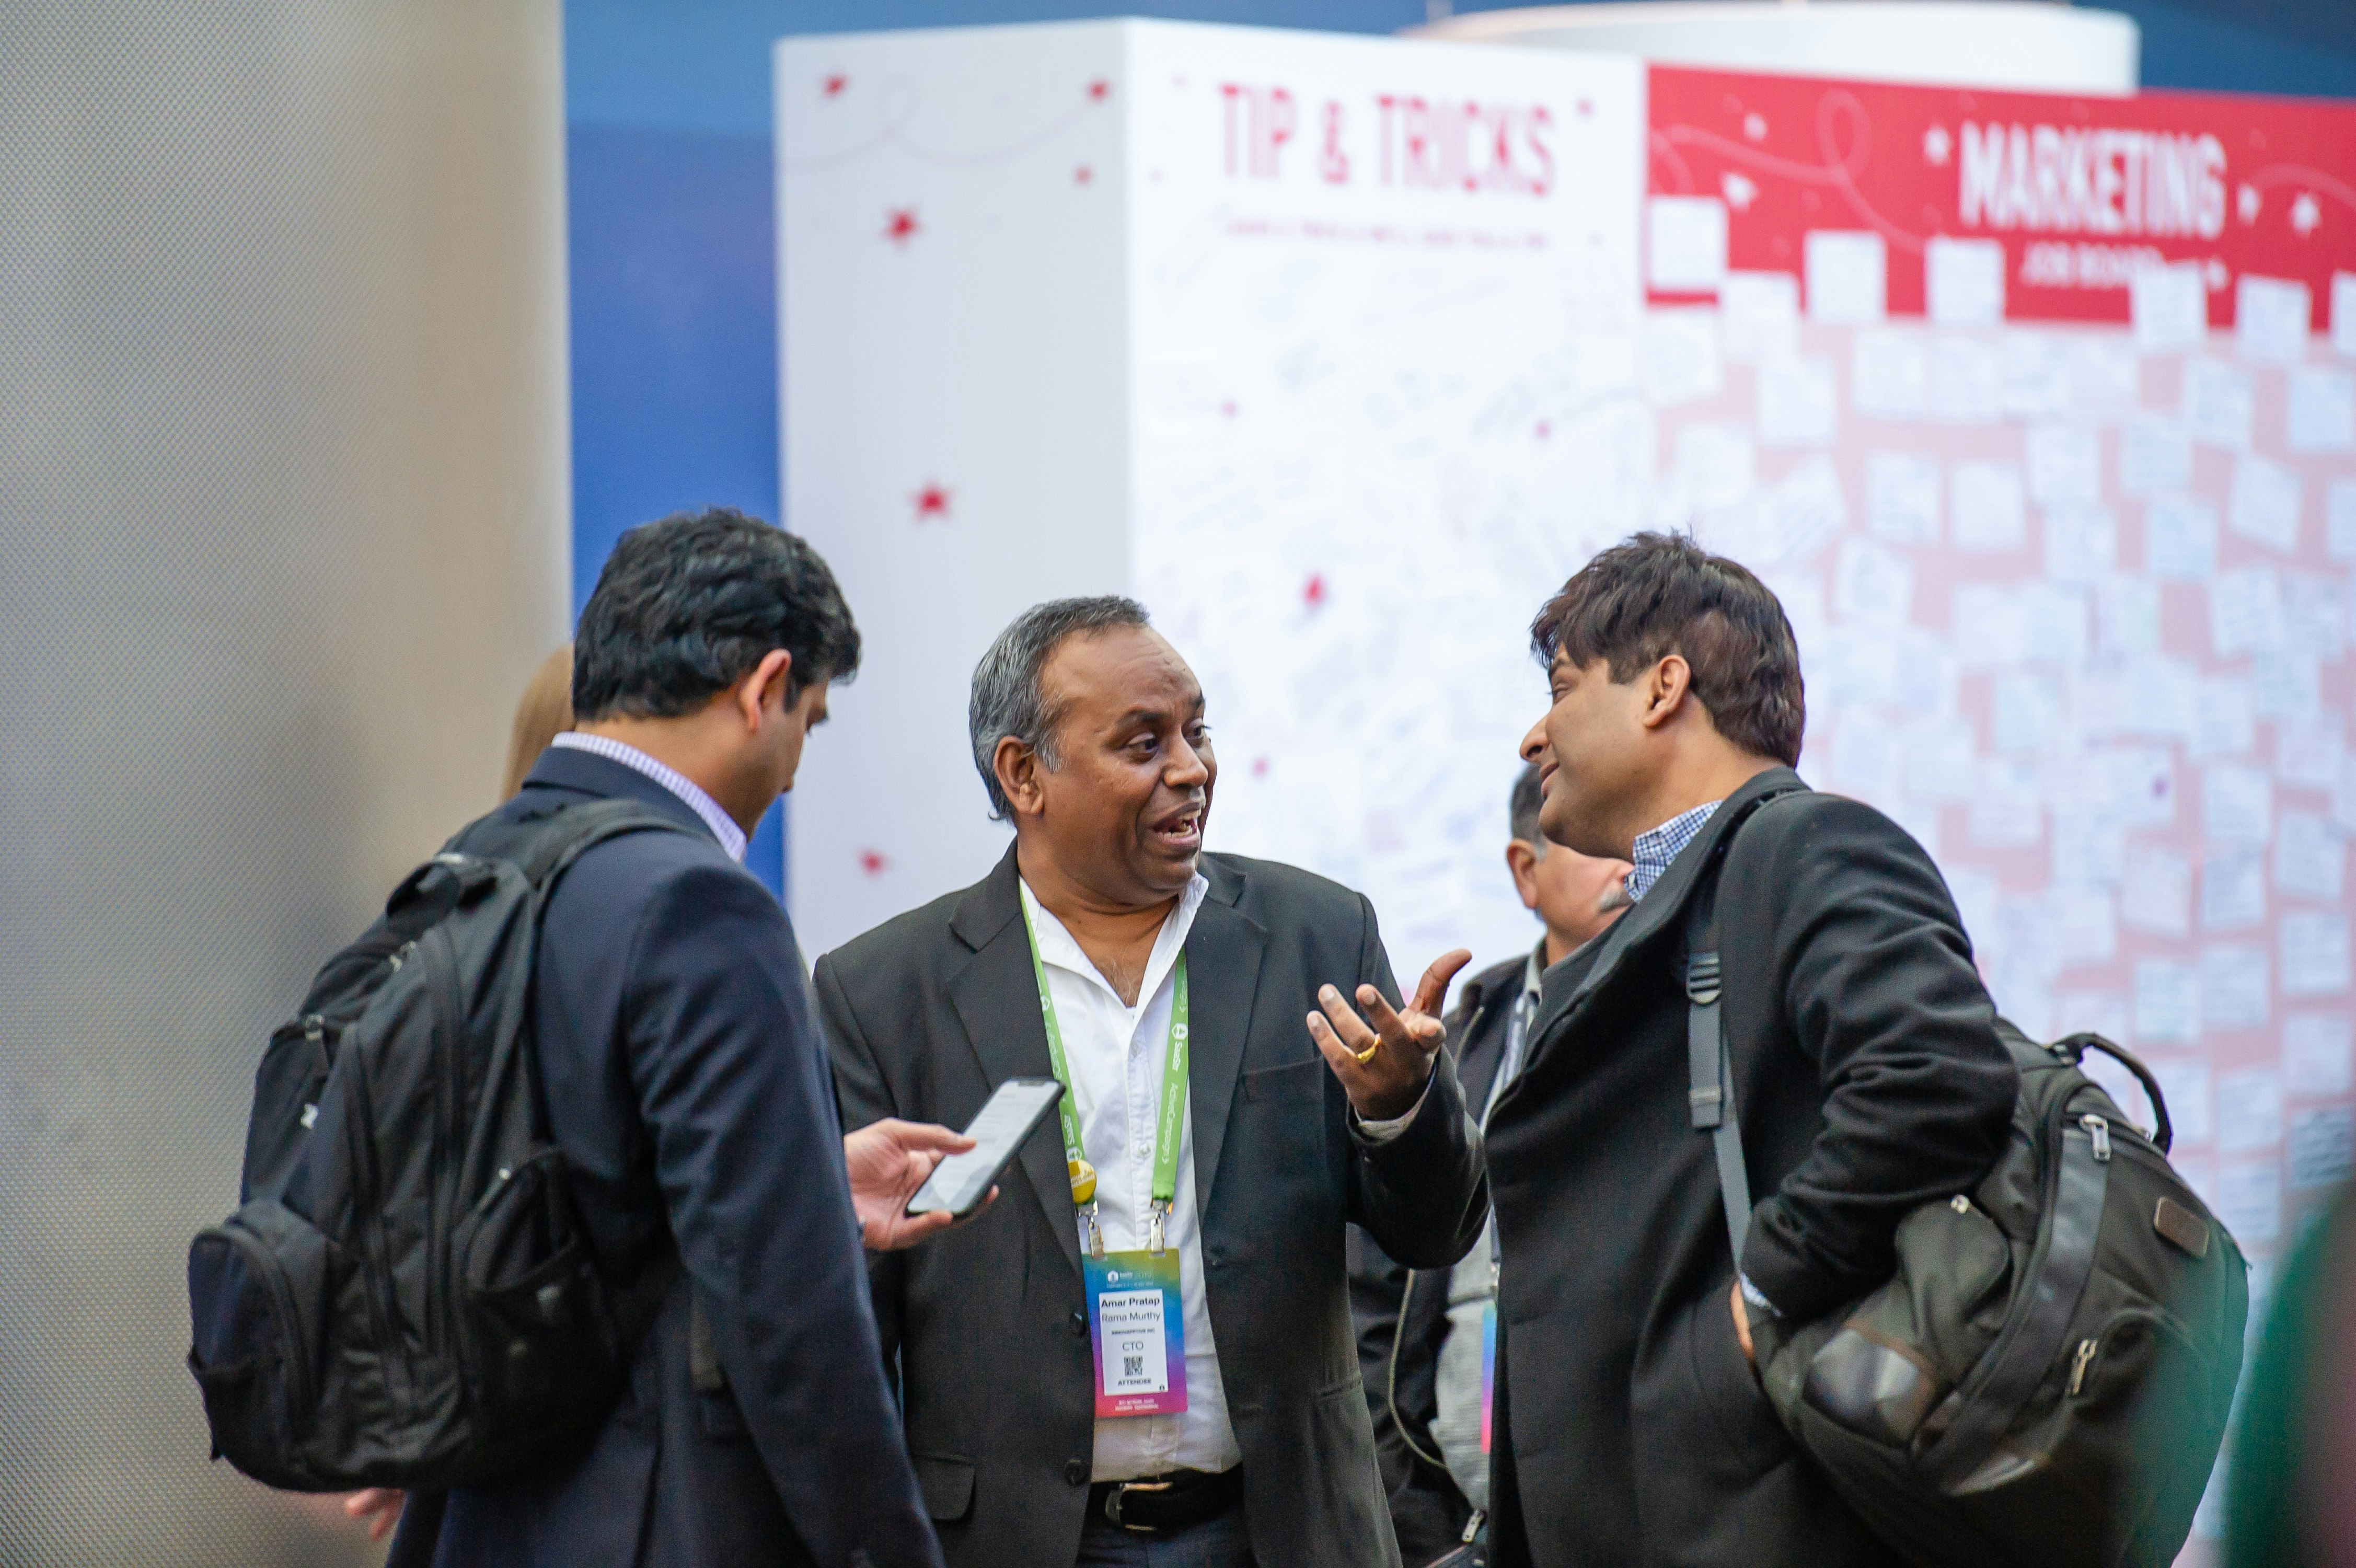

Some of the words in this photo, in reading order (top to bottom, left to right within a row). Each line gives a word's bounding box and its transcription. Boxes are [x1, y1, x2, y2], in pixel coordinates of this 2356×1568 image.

[1220, 83, 1298, 178] TIP
[1320, 101, 1349, 184] &
[1373, 93, 1556, 197] TRICKS
[1958, 120, 2227, 240] MARKETING
[1129, 1297, 1160, 1307] Pratap
[1102, 1312, 1127, 1322] Rama
[1130, 1310, 1160, 1321] Murthy
[1122, 1341, 1144, 1351] CTO
